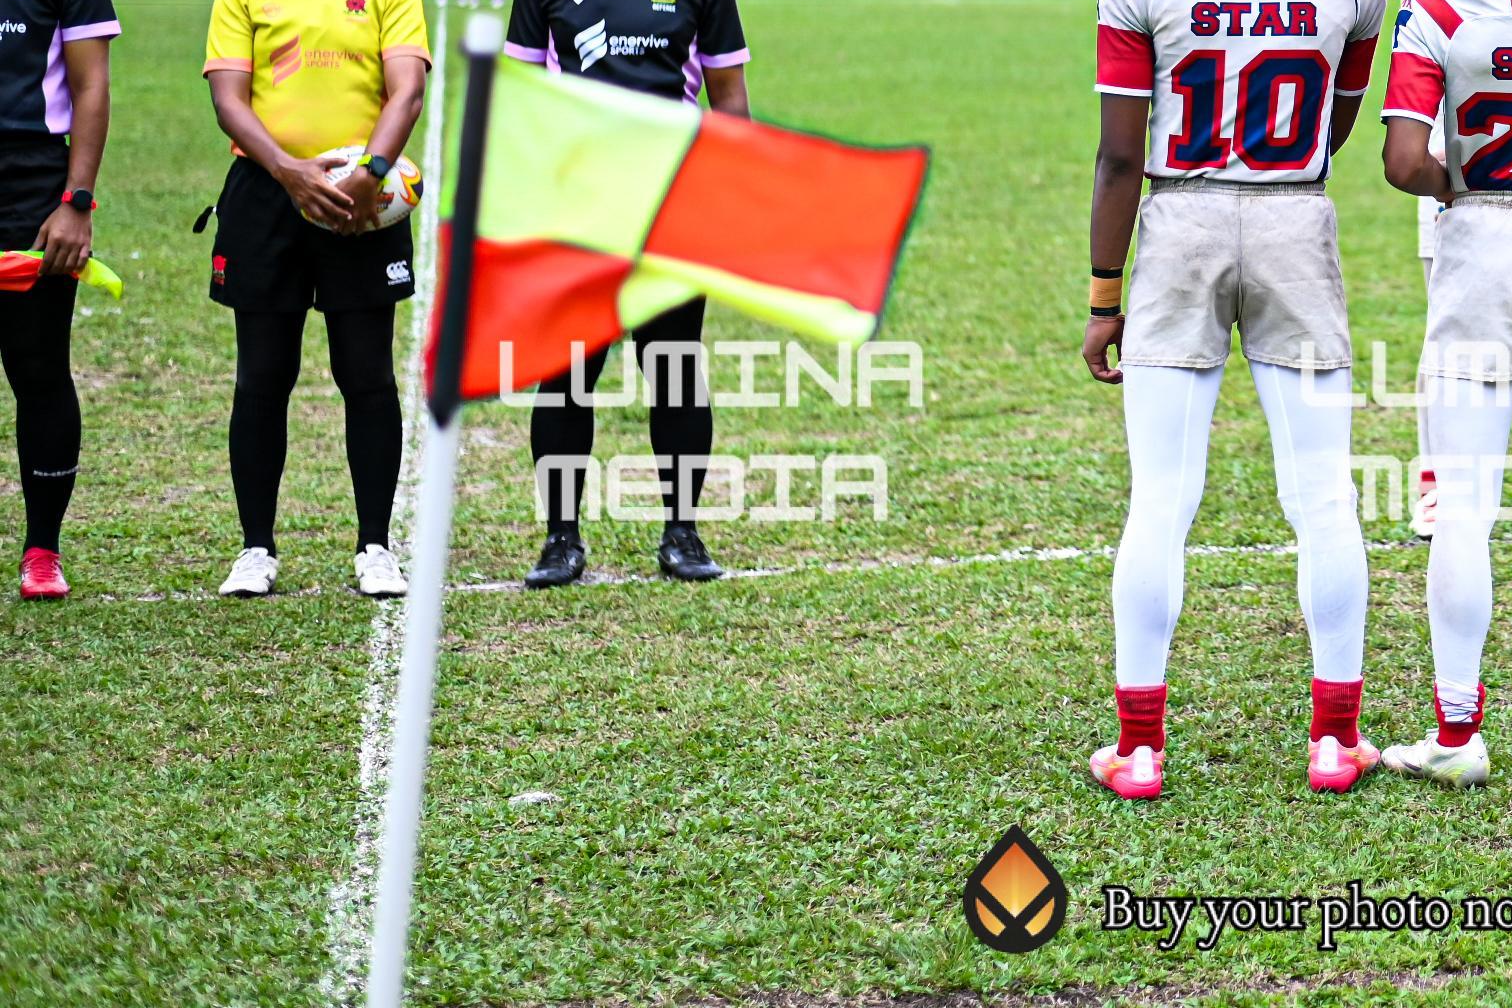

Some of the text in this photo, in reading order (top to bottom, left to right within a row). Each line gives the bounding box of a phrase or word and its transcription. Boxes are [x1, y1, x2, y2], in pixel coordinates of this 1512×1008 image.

[1191, 1, 1318, 37] STAR
[609, 34, 669, 49] enervive
[610, 46, 645, 56] SPORTS
[1166, 49, 1331, 170] 10
